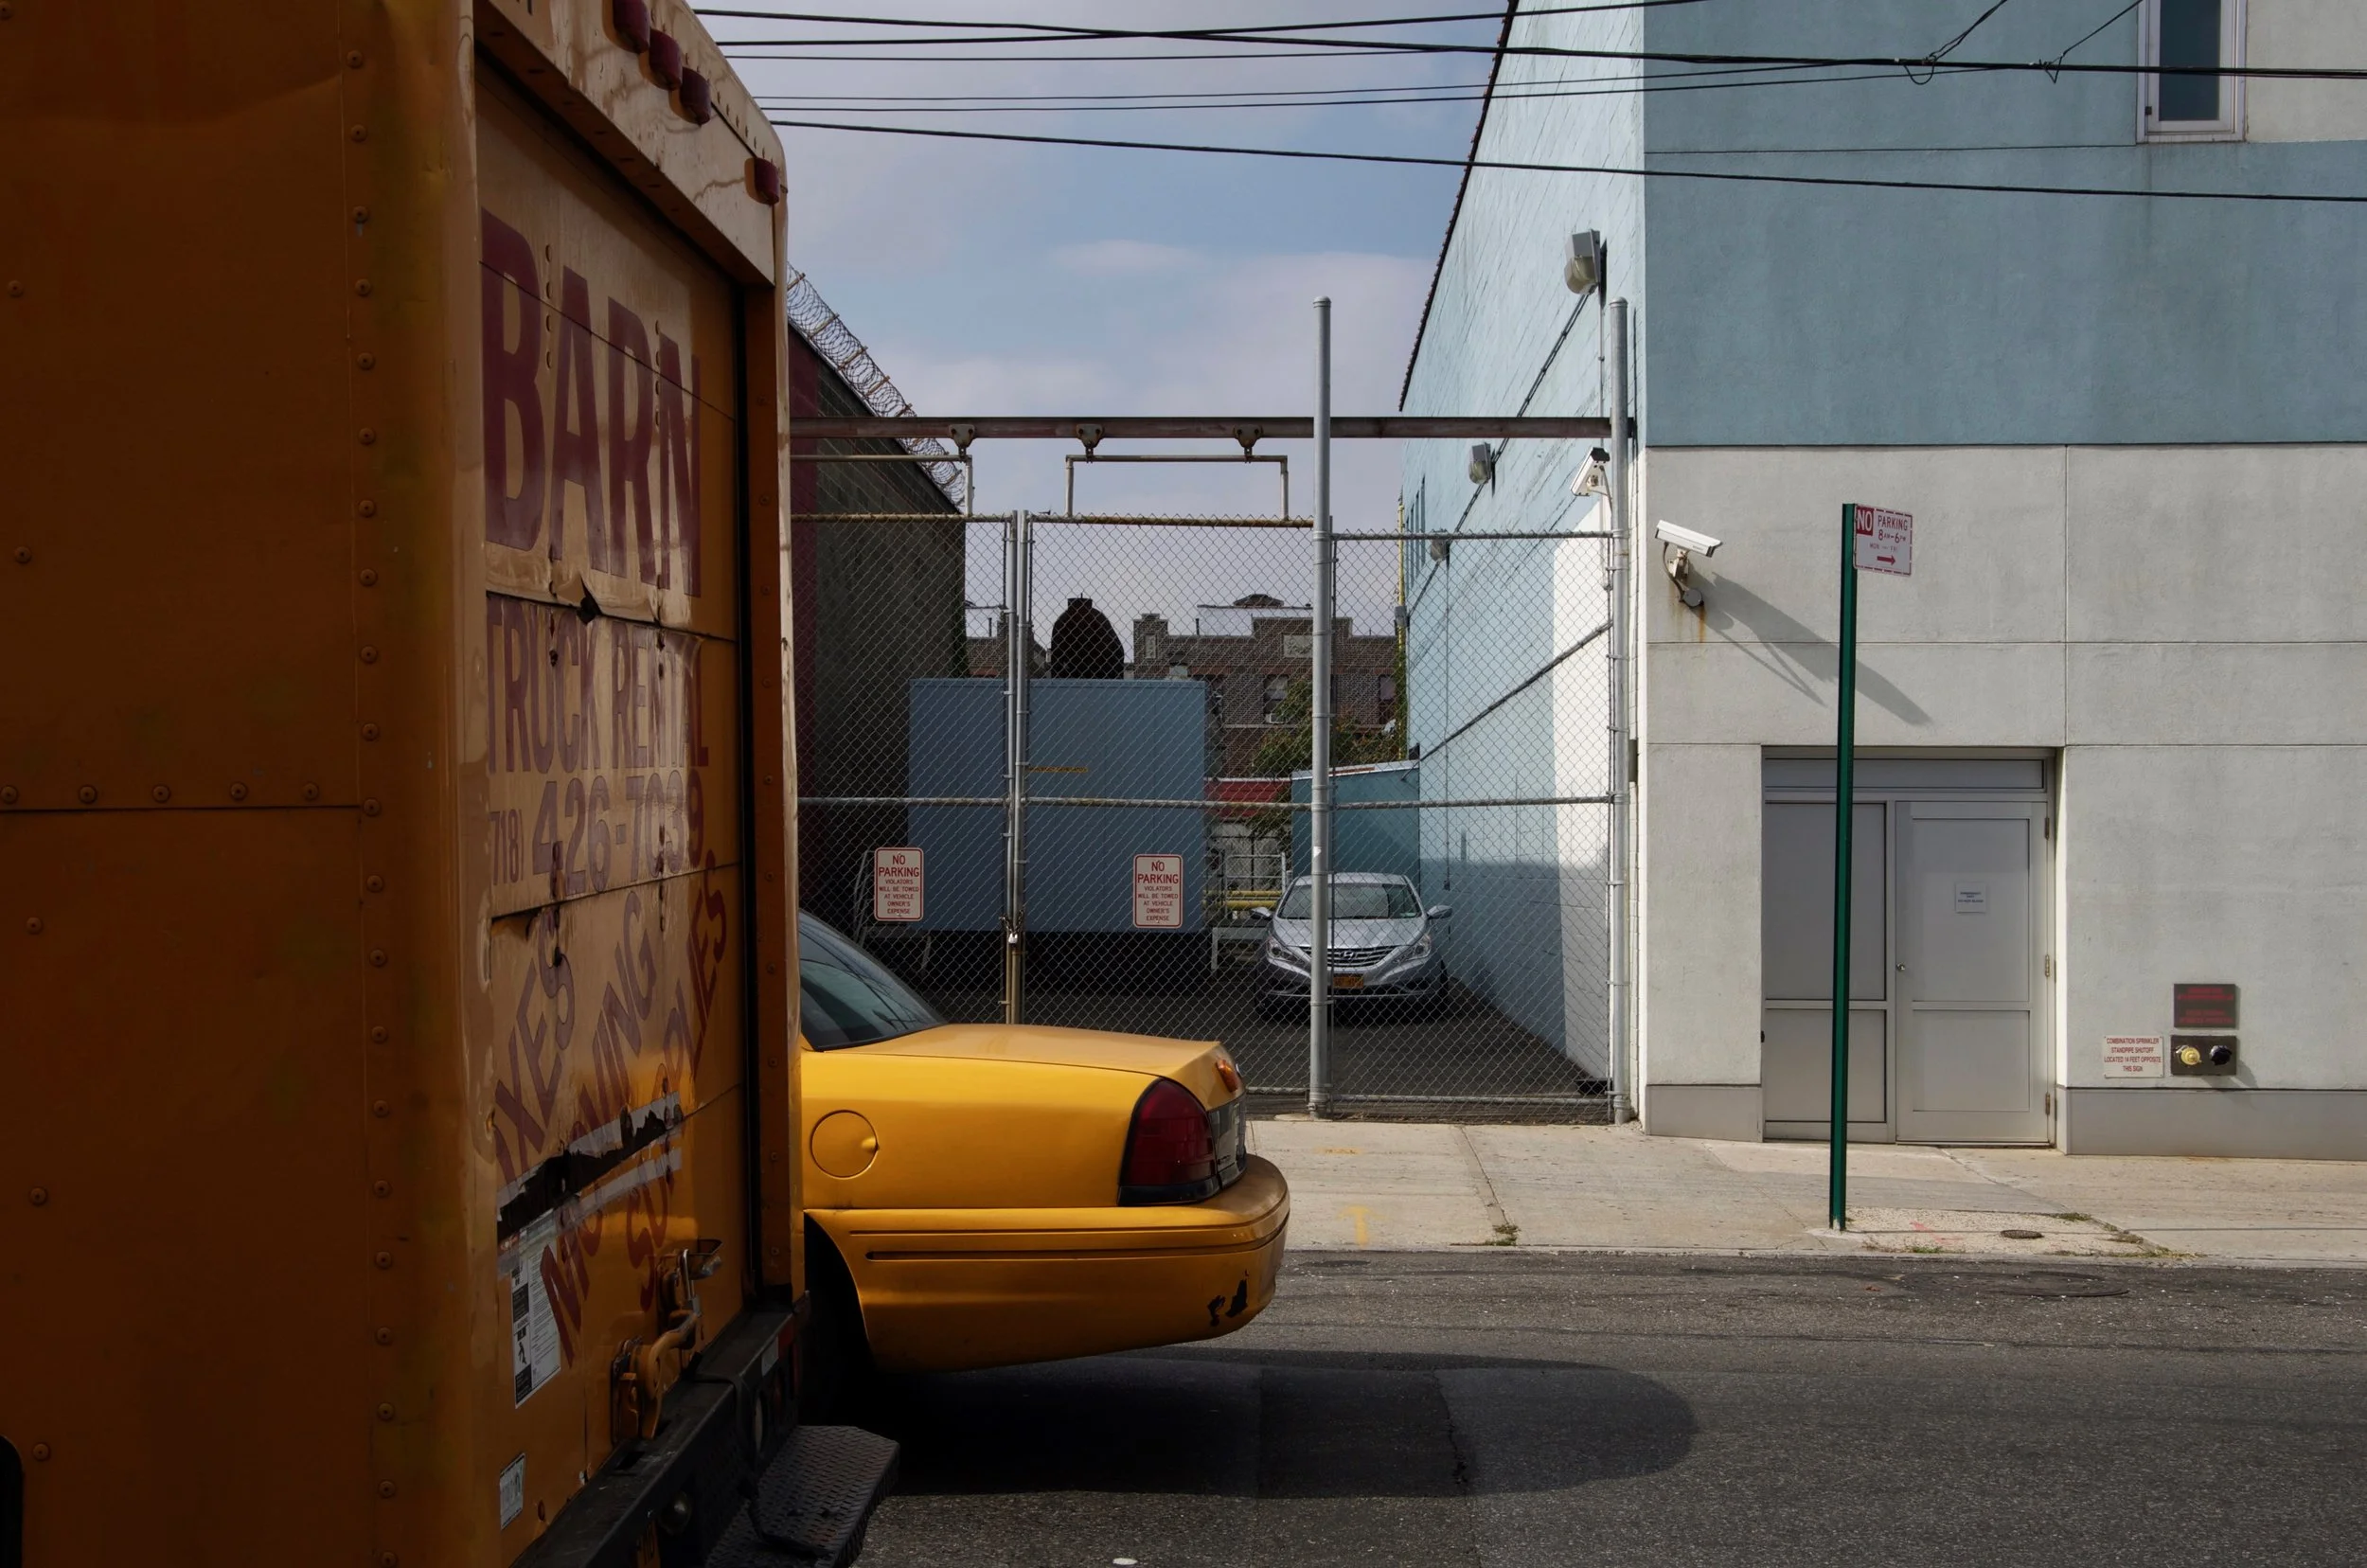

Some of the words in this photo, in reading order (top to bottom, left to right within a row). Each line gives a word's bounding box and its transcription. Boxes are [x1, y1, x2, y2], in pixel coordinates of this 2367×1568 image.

[481, 205, 702, 597] BARN
[1857, 509, 1873, 531] NO
[1878, 515, 1908, 531] PARKING
[487, 593, 599, 773] TRUCK
[612, 621, 708, 769] RENTAL
[893, 855, 905, 864] NO
[1151, 862, 1165, 871] NO
[879, 867, 919, 877] PARKING
[1138, 874, 1179, 883] PARKING
